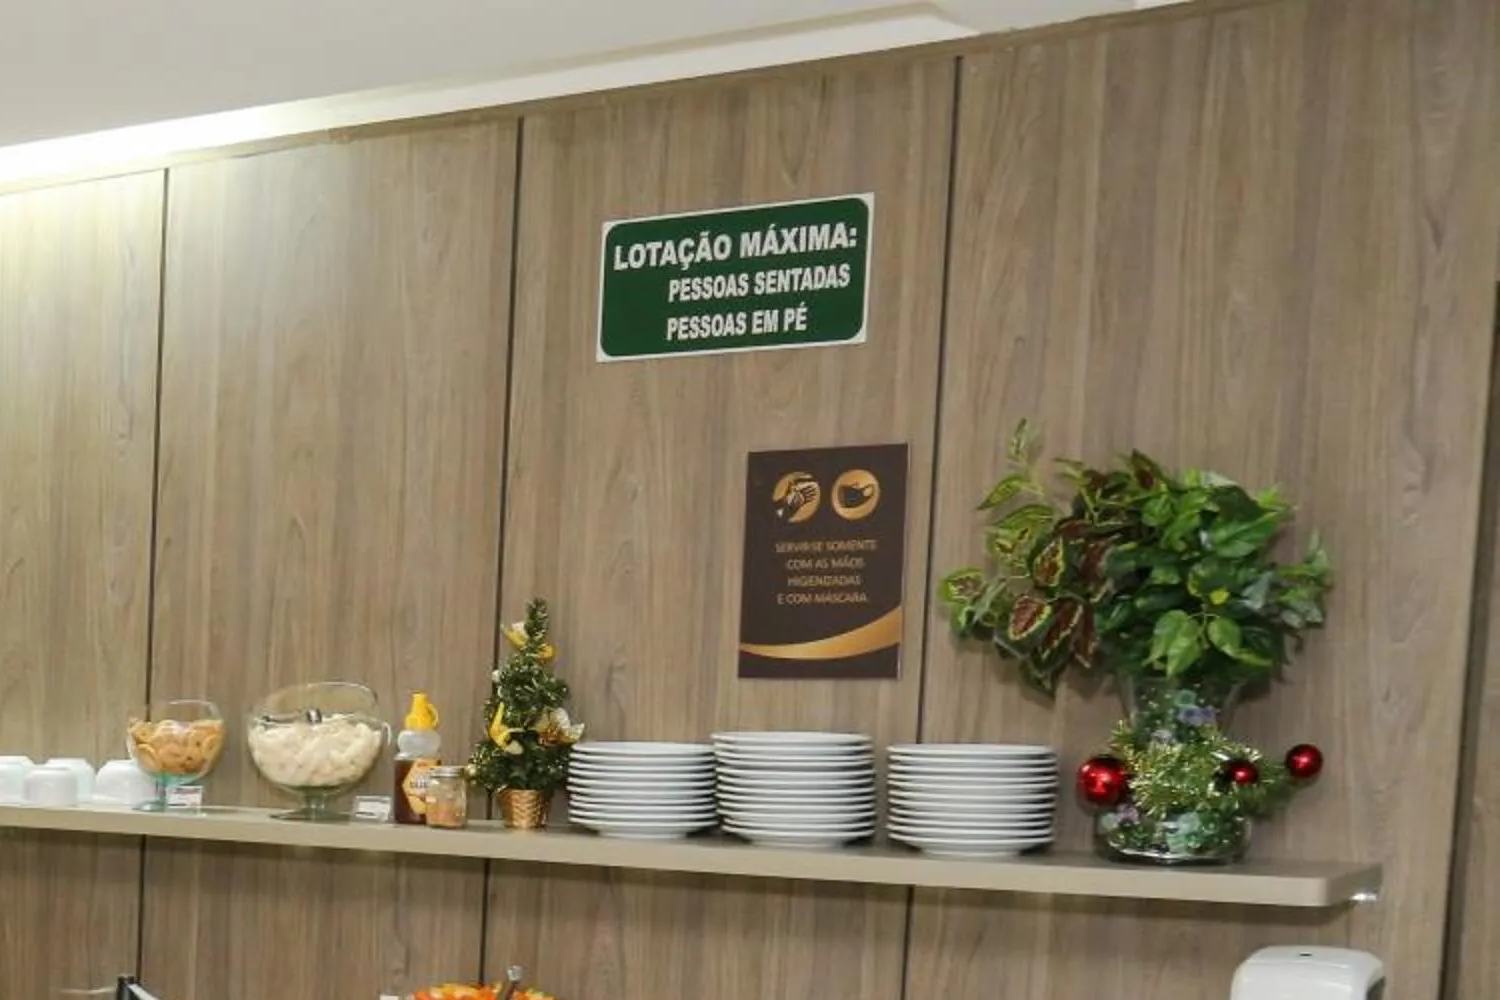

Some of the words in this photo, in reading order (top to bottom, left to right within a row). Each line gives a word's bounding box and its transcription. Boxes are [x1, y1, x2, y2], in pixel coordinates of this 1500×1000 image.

[613, 231, 732, 271] LOTAÇÃO
[740, 222, 857, 258] MÁXIMA:
[668, 273, 748, 302] PESSOAS
[754, 263, 850, 295] SENTADAS
[667, 311, 747, 341] PESSOAS
[752, 309, 778, 335] EM
[784, 302, 808, 331] PÉ
[787, 559, 812, 570] COM
[815, 558, 828, 569] AS
